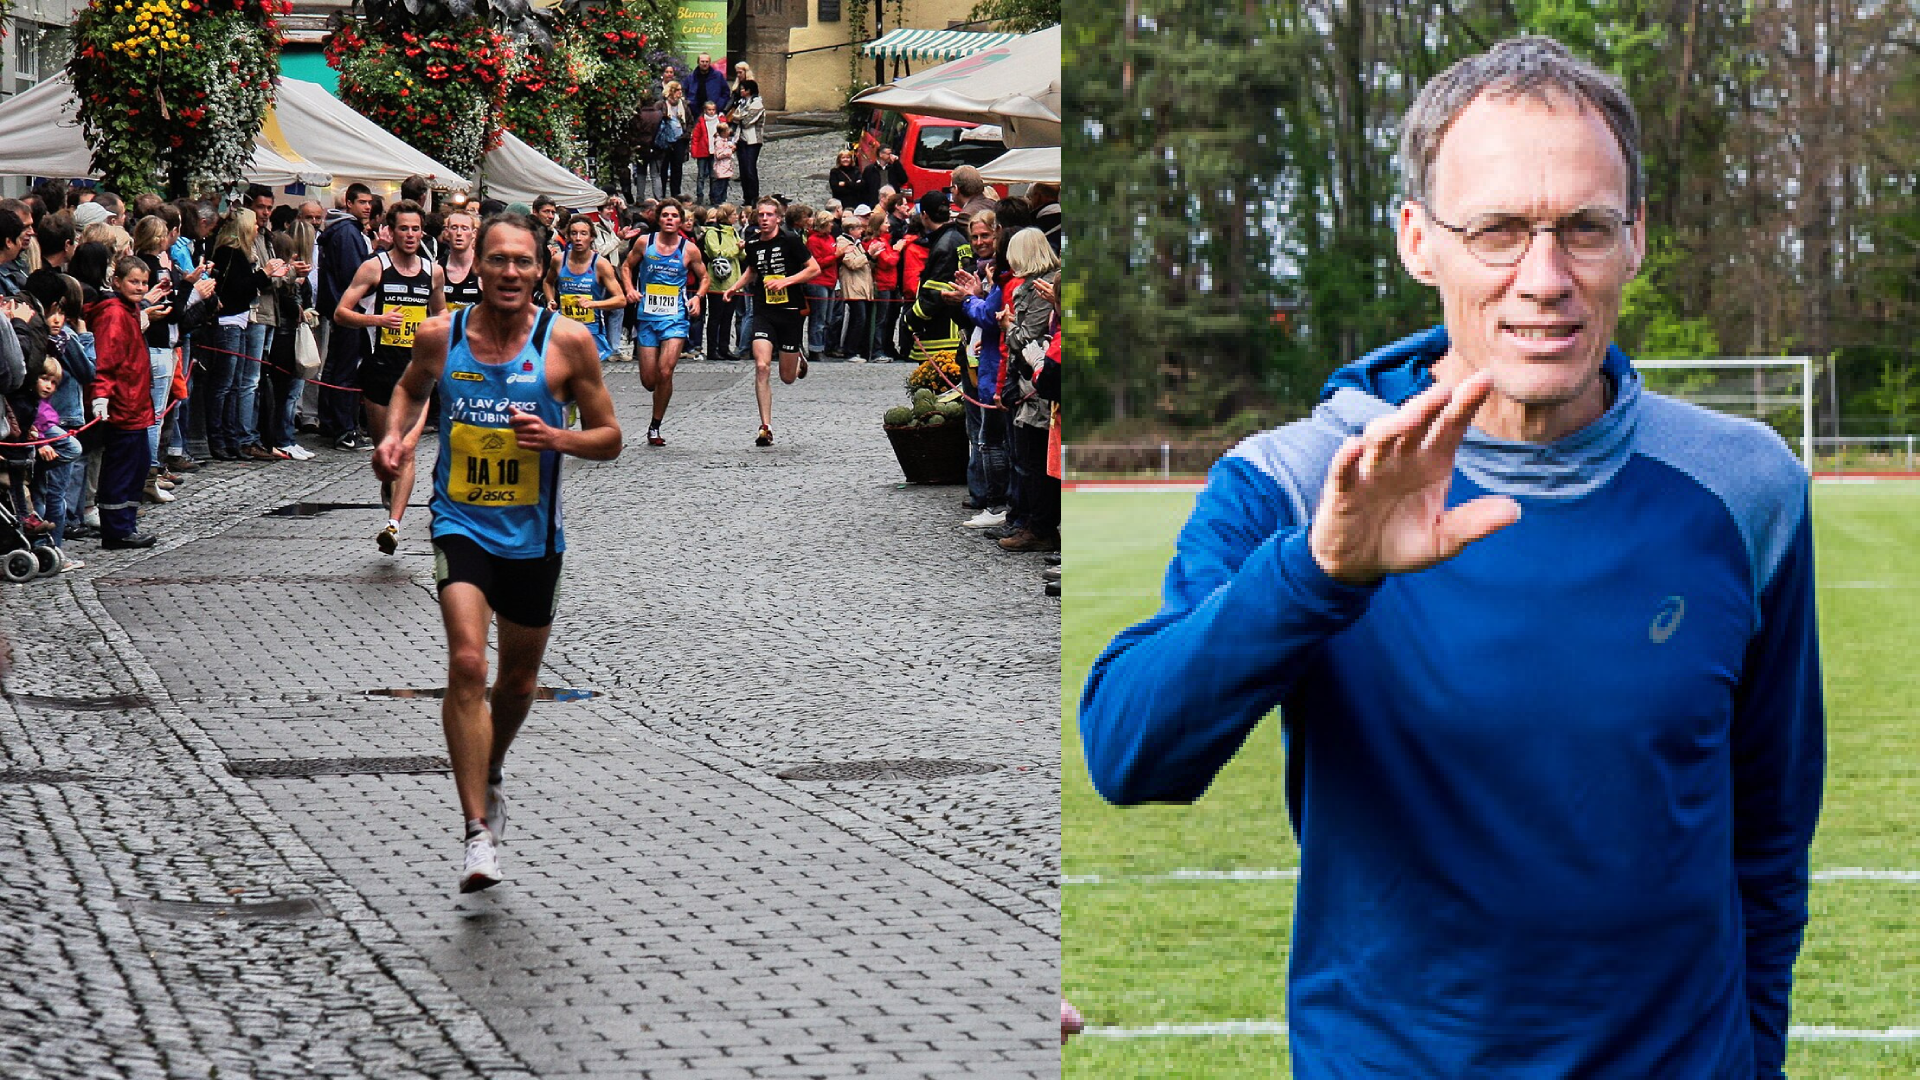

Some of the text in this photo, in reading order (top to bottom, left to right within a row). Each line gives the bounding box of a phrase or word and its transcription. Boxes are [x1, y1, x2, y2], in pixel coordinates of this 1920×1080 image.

[677, 6, 718, 20] Blumen
[659, 296, 675, 307] 1213
[404, 321, 421, 336] 54
[469, 398, 493, 409] LAV
[470, 411, 510, 424] TÜBIN
[466, 456, 519, 485] HA 10
[482, 490, 515, 502] asics
